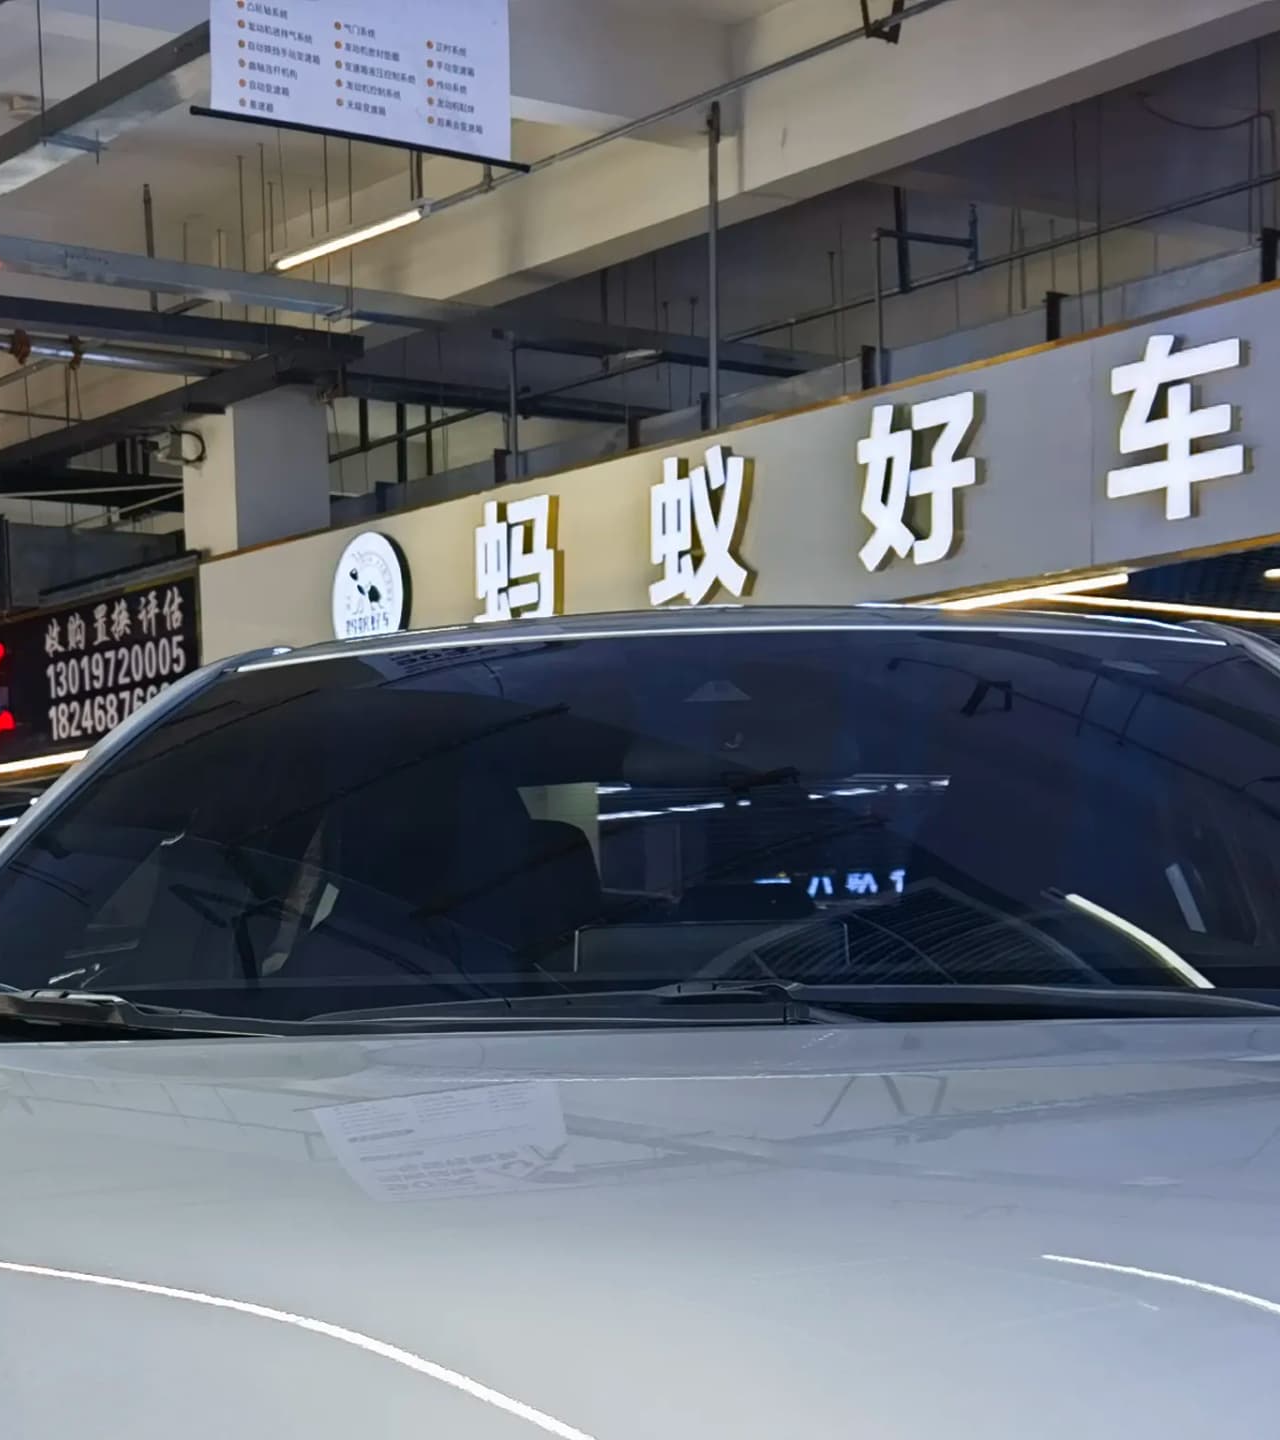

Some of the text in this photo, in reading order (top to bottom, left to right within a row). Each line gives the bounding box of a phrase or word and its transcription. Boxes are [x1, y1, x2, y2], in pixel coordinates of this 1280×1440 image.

[473, 334, 1245, 622] 蚂蚁好车
[46, 635, 186, 699] 13019720005
